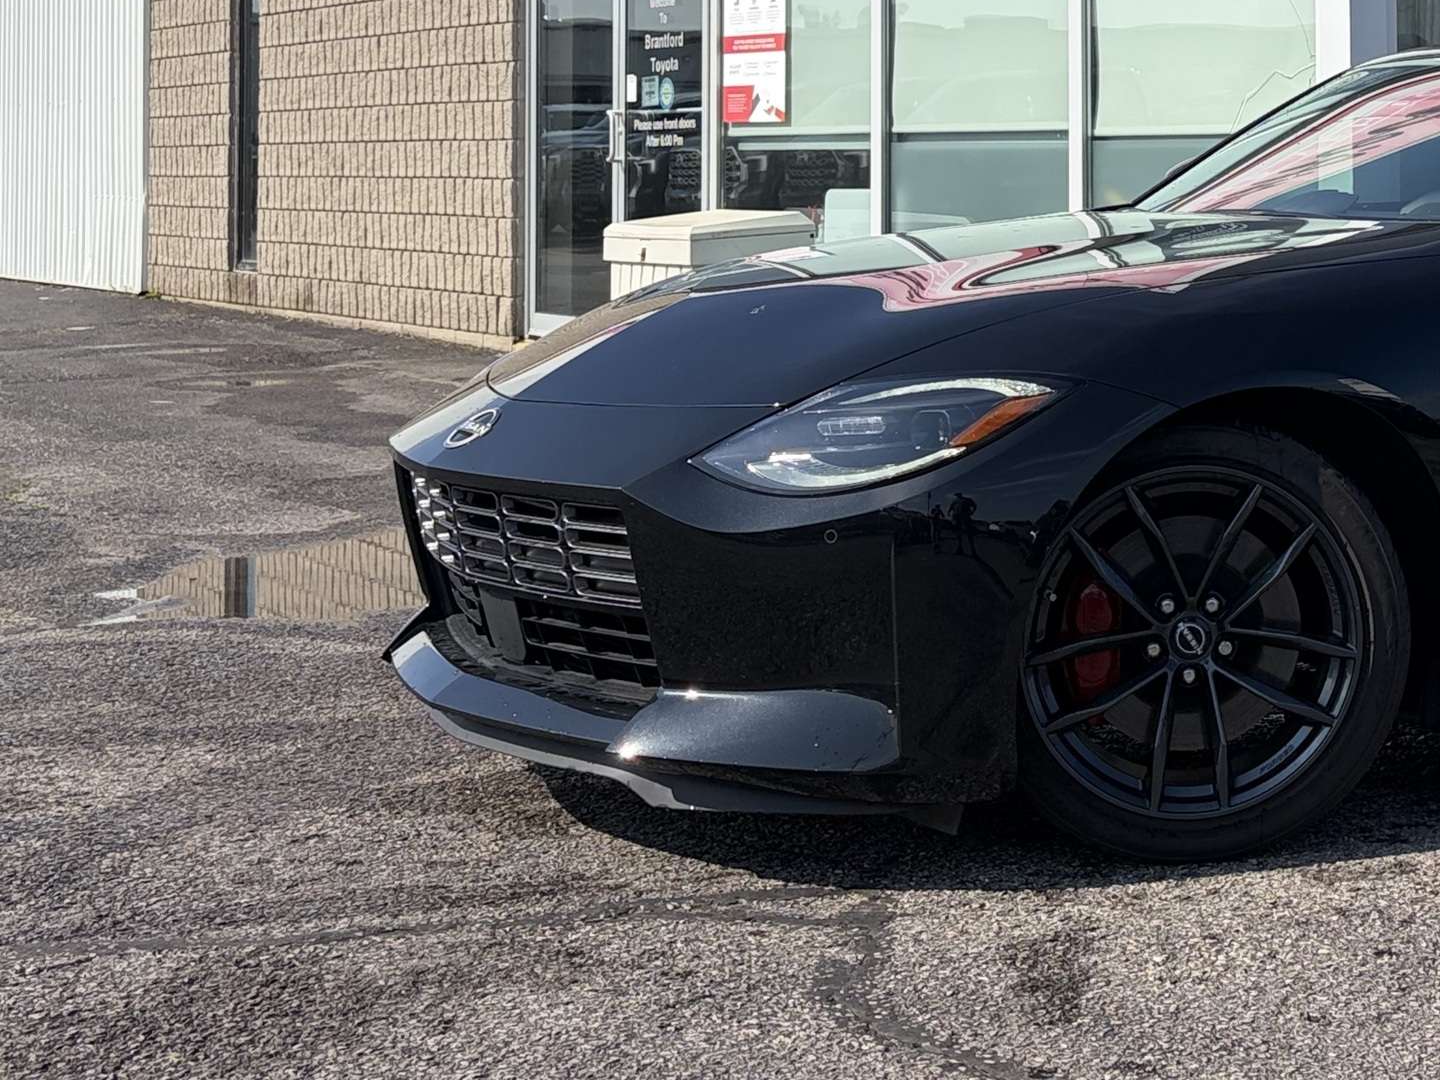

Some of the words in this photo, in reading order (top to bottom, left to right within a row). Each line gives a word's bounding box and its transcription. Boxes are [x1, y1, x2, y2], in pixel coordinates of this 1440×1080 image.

[659, 12, 668, 24] To
[644, 31, 684, 50] Brantford
[649, 57, 679, 75] Toyota
[633, 119, 652, 131] Please
[678, 117, 696, 129] doors
